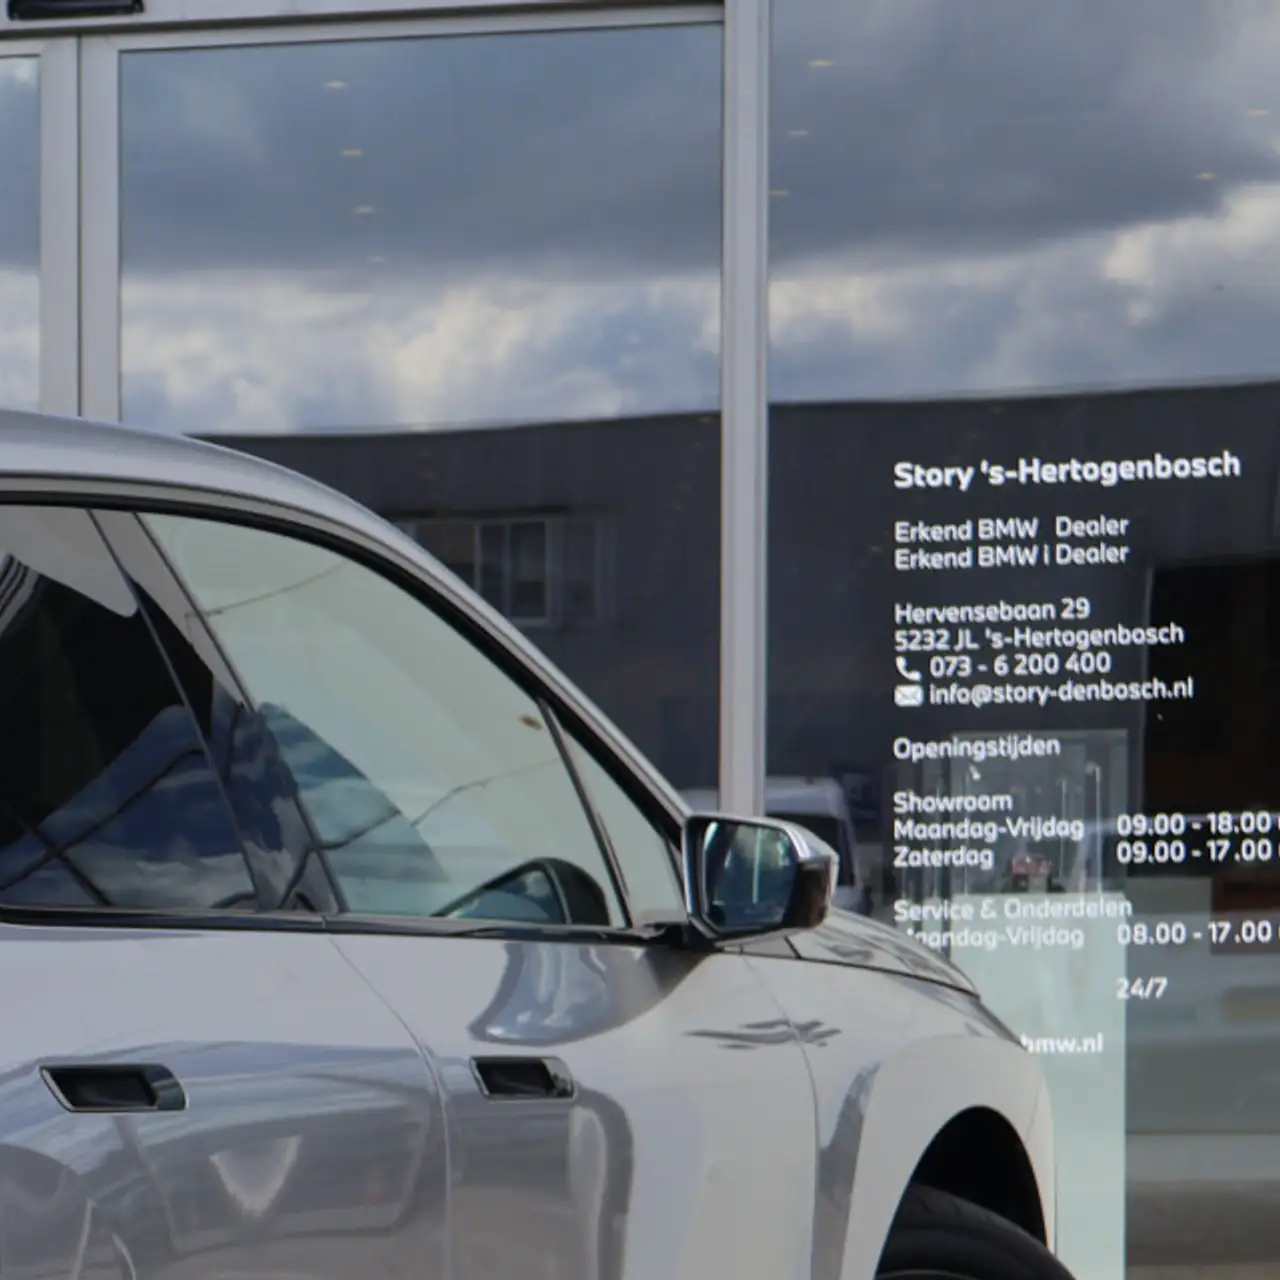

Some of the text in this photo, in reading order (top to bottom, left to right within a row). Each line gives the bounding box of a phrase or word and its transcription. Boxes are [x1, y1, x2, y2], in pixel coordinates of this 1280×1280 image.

[894, 450, 1241, 491] Story 's-Hertogenbosch
[894, 515, 1130, 543] Erkend BMW Dealer
[894, 542, 1130, 570] Erkend BMW i Dealer
[894, 598, 1091, 625] Hervensebaan 29
[894, 622, 1185, 651] 5232 JL 's-Hertogenbosch
[929, 656, 972, 678] 073
[993, 654, 1010, 675] 6
[1014, 652, 1059, 674] 200
[1065, 652, 1112, 673] 400
[929, 676, 1194, 707] info@story-denbosch.nl
[893, 734, 1061, 762] Openingstijden
[893, 791, 1013, 814] Showroom
[893, 816, 1085, 842] Maandag-Vrijdag
[1116, 813, 1185, 837] 09.00
[1206, 811, 1272, 835] 18.00
[893, 845, 994, 871] Zaterdag
[1116, 841, 1185, 865] 09.00
[893, 896, 1133, 922] Service & Onderdelen
[906, 924, 1085, 951] aandag-Vrijdag
[1116, 922, 1186, 945] 08.00
[1115, 976, 1168, 1000] 24/7
